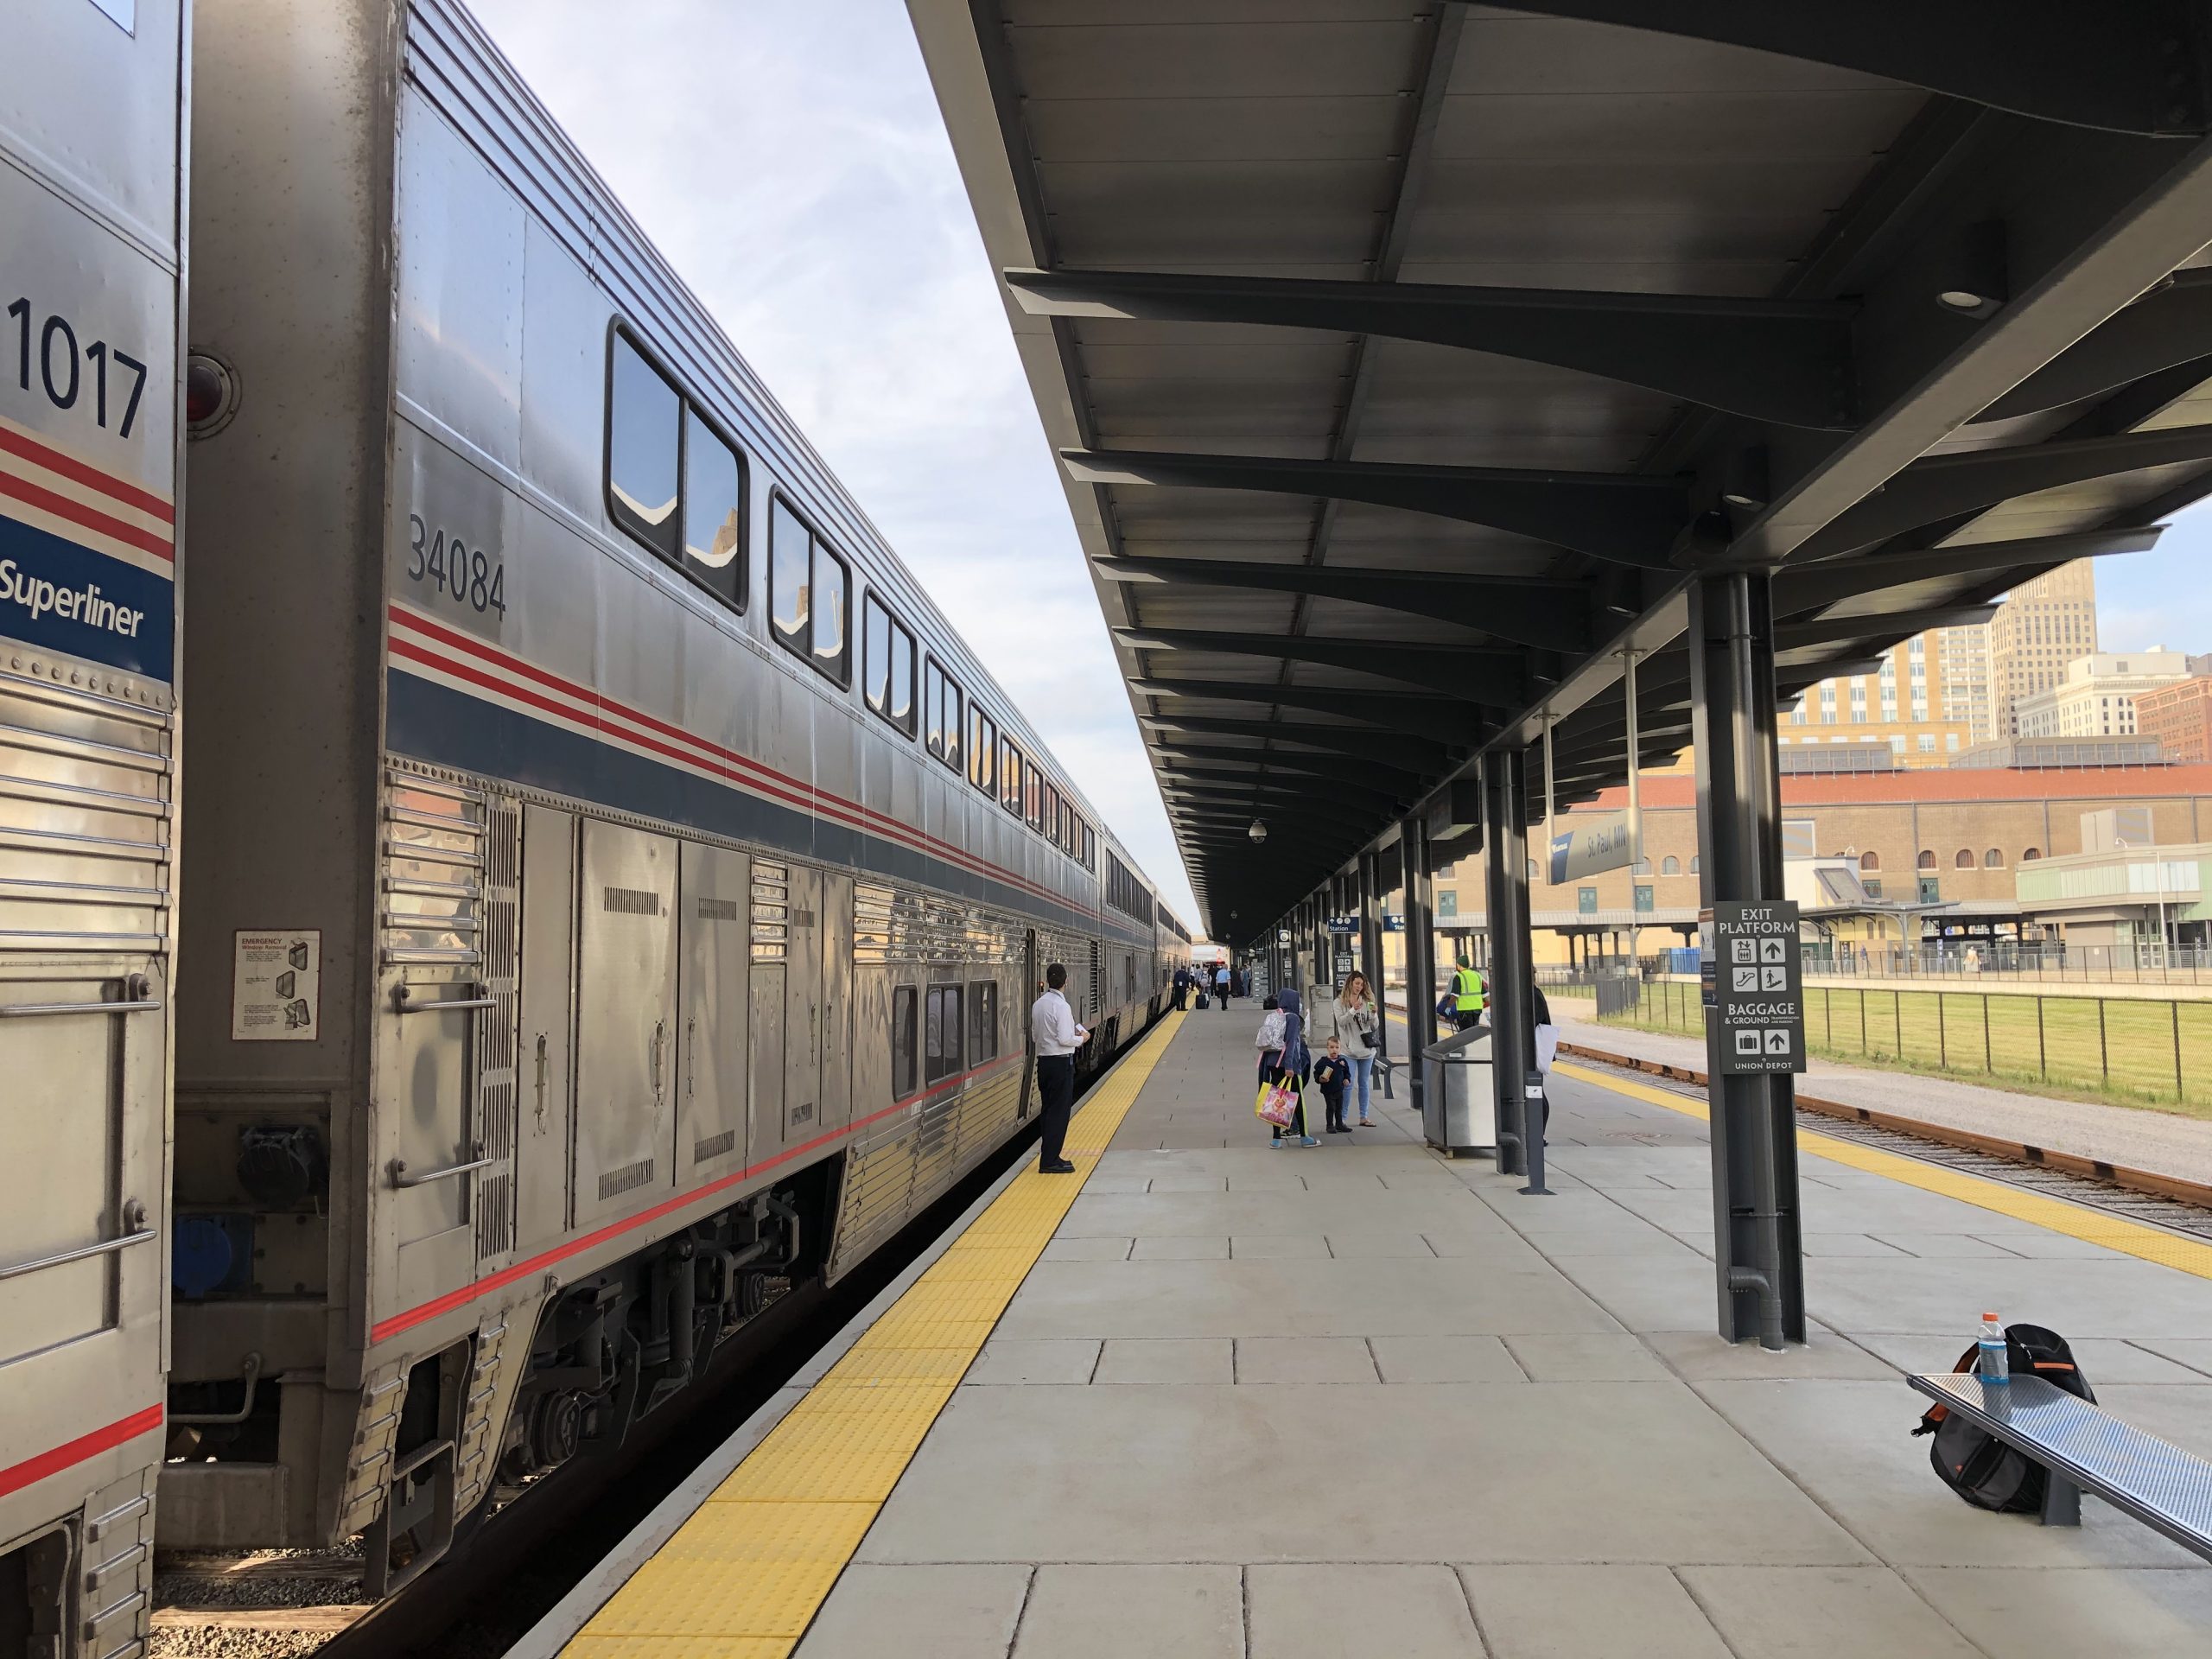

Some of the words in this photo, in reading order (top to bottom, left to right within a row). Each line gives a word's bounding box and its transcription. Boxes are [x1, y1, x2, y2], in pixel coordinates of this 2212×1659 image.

[8, 296, 147, 440] 1017
[407, 513, 506, 622] 34084
[0, 558, 143, 639] Superliner
[1614, 823, 1626, 849] MN
[1741, 908, 1772, 920] EXIT
[1719, 921, 1796, 934] PLATFORM
[1728, 1002, 1796, 1015] BAGGAGE
[1732, 1016, 1770, 1025] GROUND
